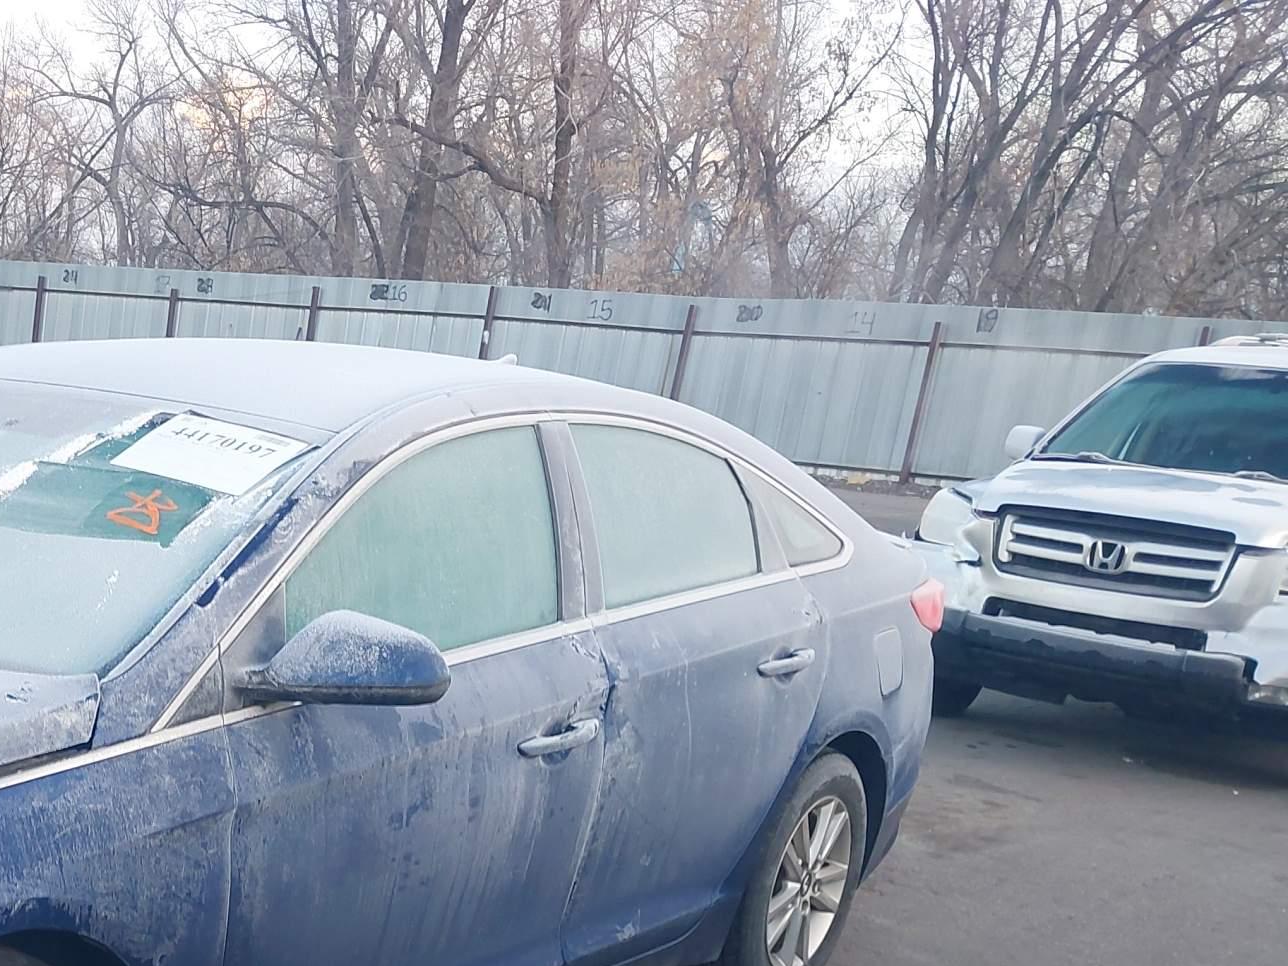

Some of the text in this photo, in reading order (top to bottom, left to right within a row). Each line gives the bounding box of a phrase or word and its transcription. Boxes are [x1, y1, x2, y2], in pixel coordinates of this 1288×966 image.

[391, 284, 408, 302] 16
[586, 299, 613, 322] 15
[172, 427, 276, 458] 44170197
